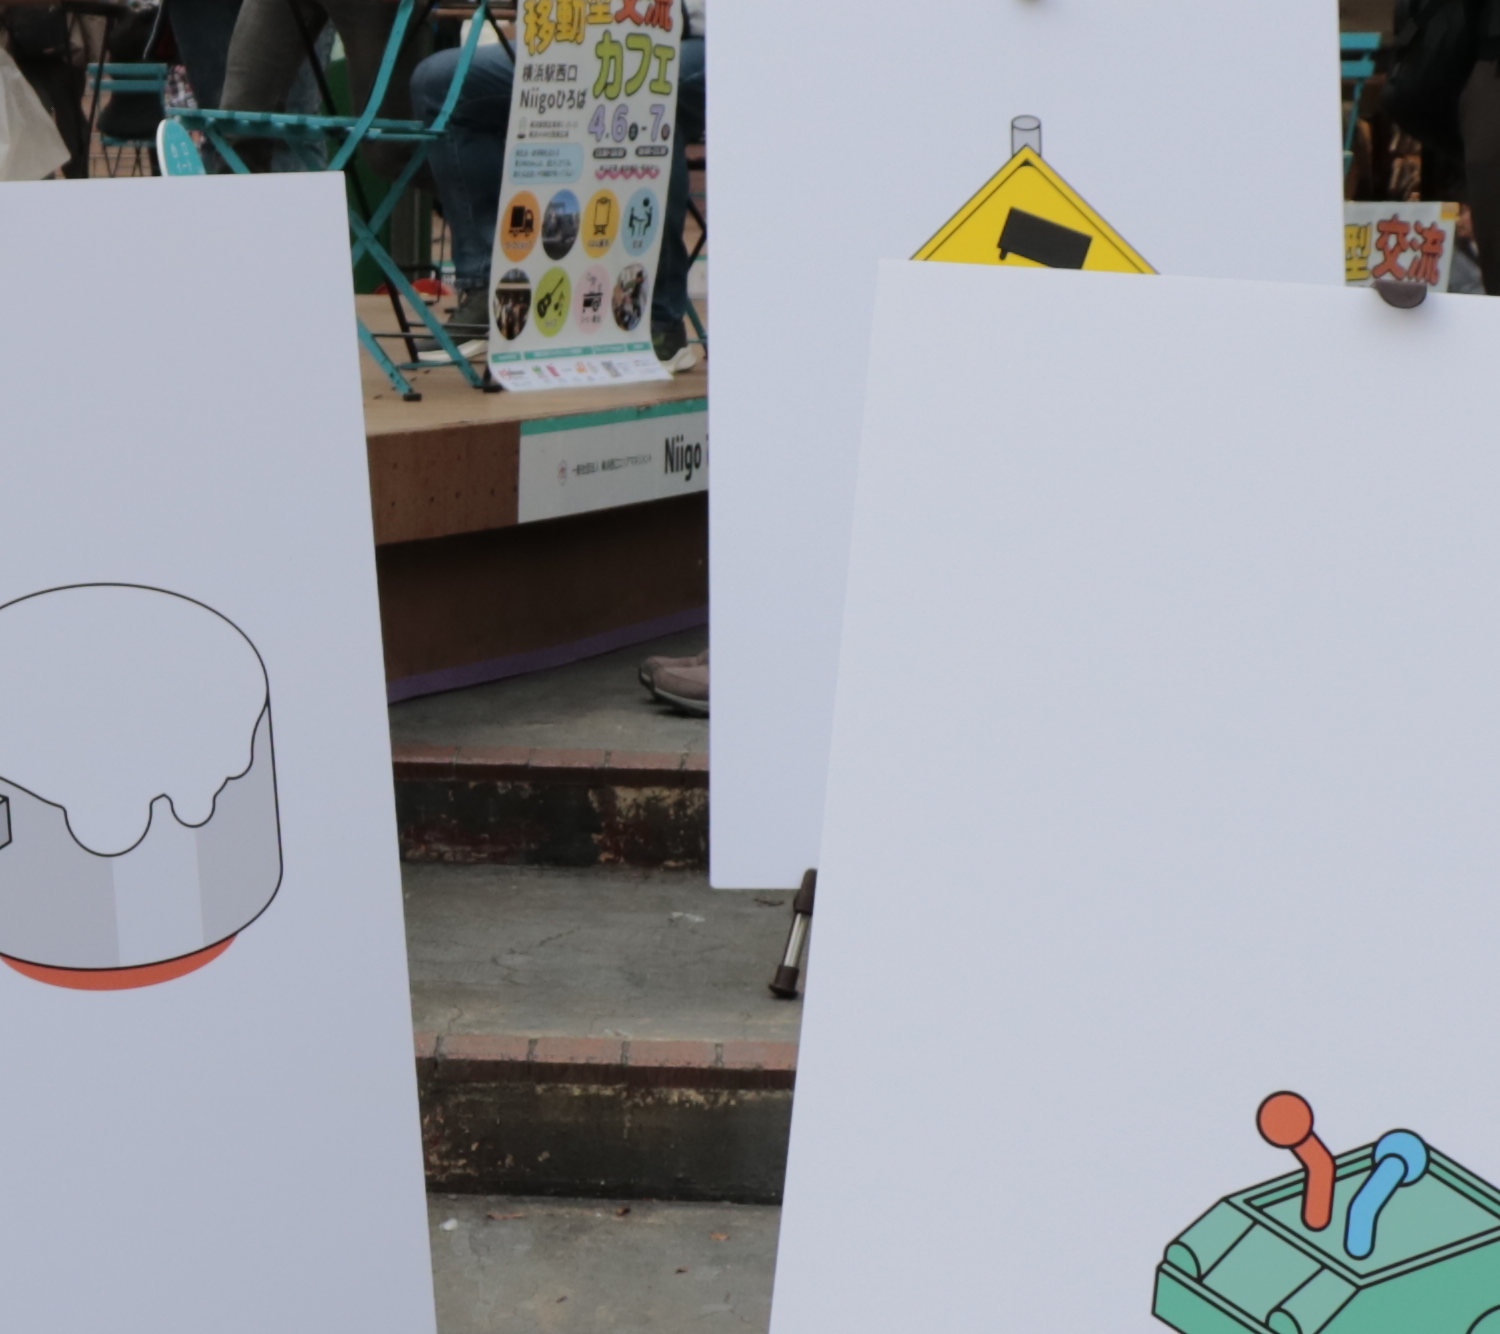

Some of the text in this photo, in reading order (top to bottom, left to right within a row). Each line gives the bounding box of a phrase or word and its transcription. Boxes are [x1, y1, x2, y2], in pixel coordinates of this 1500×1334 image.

[592, 31, 676, 101] カフェ
[663, 433, 703, 482] Niigo
